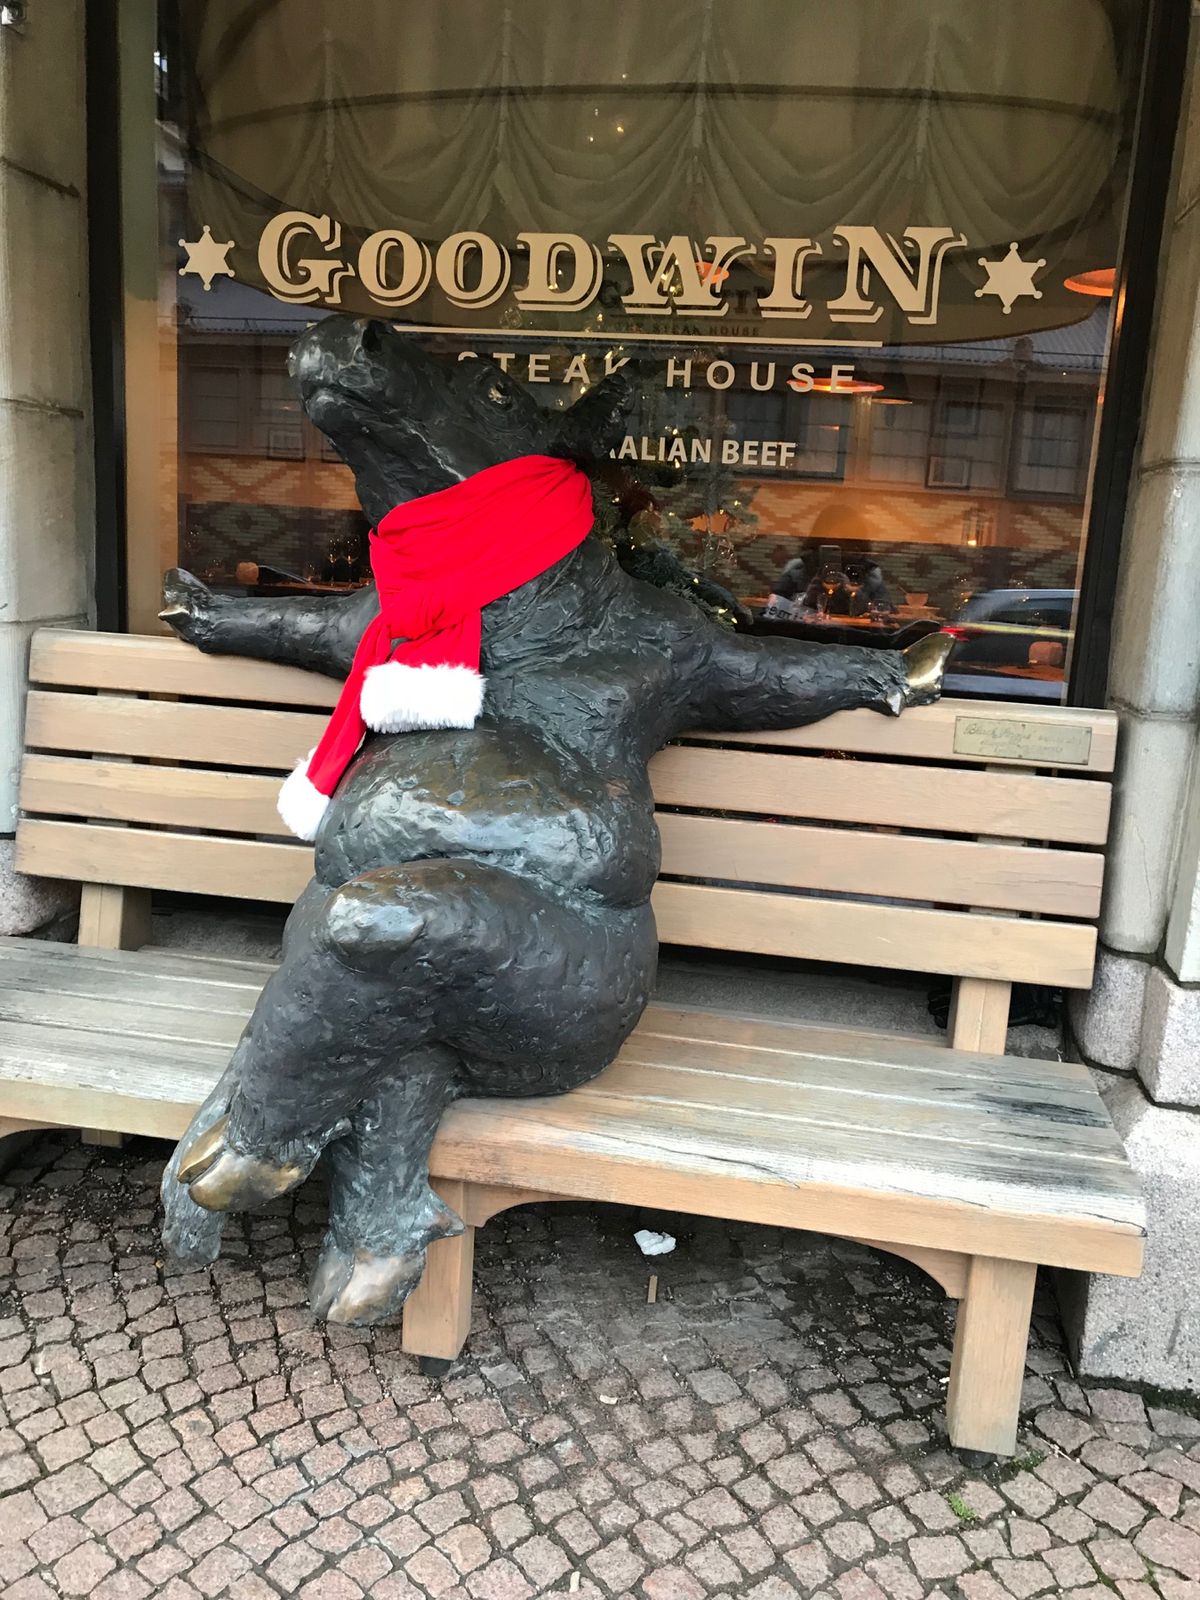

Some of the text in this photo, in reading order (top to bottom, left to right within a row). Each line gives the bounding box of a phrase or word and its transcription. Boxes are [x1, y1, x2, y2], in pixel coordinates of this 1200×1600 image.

[258, 211, 967, 326] GOODWIN
[666, 358, 856, 395] HOUSE
[609, 435, 797, 467] ALIAN BEEF
